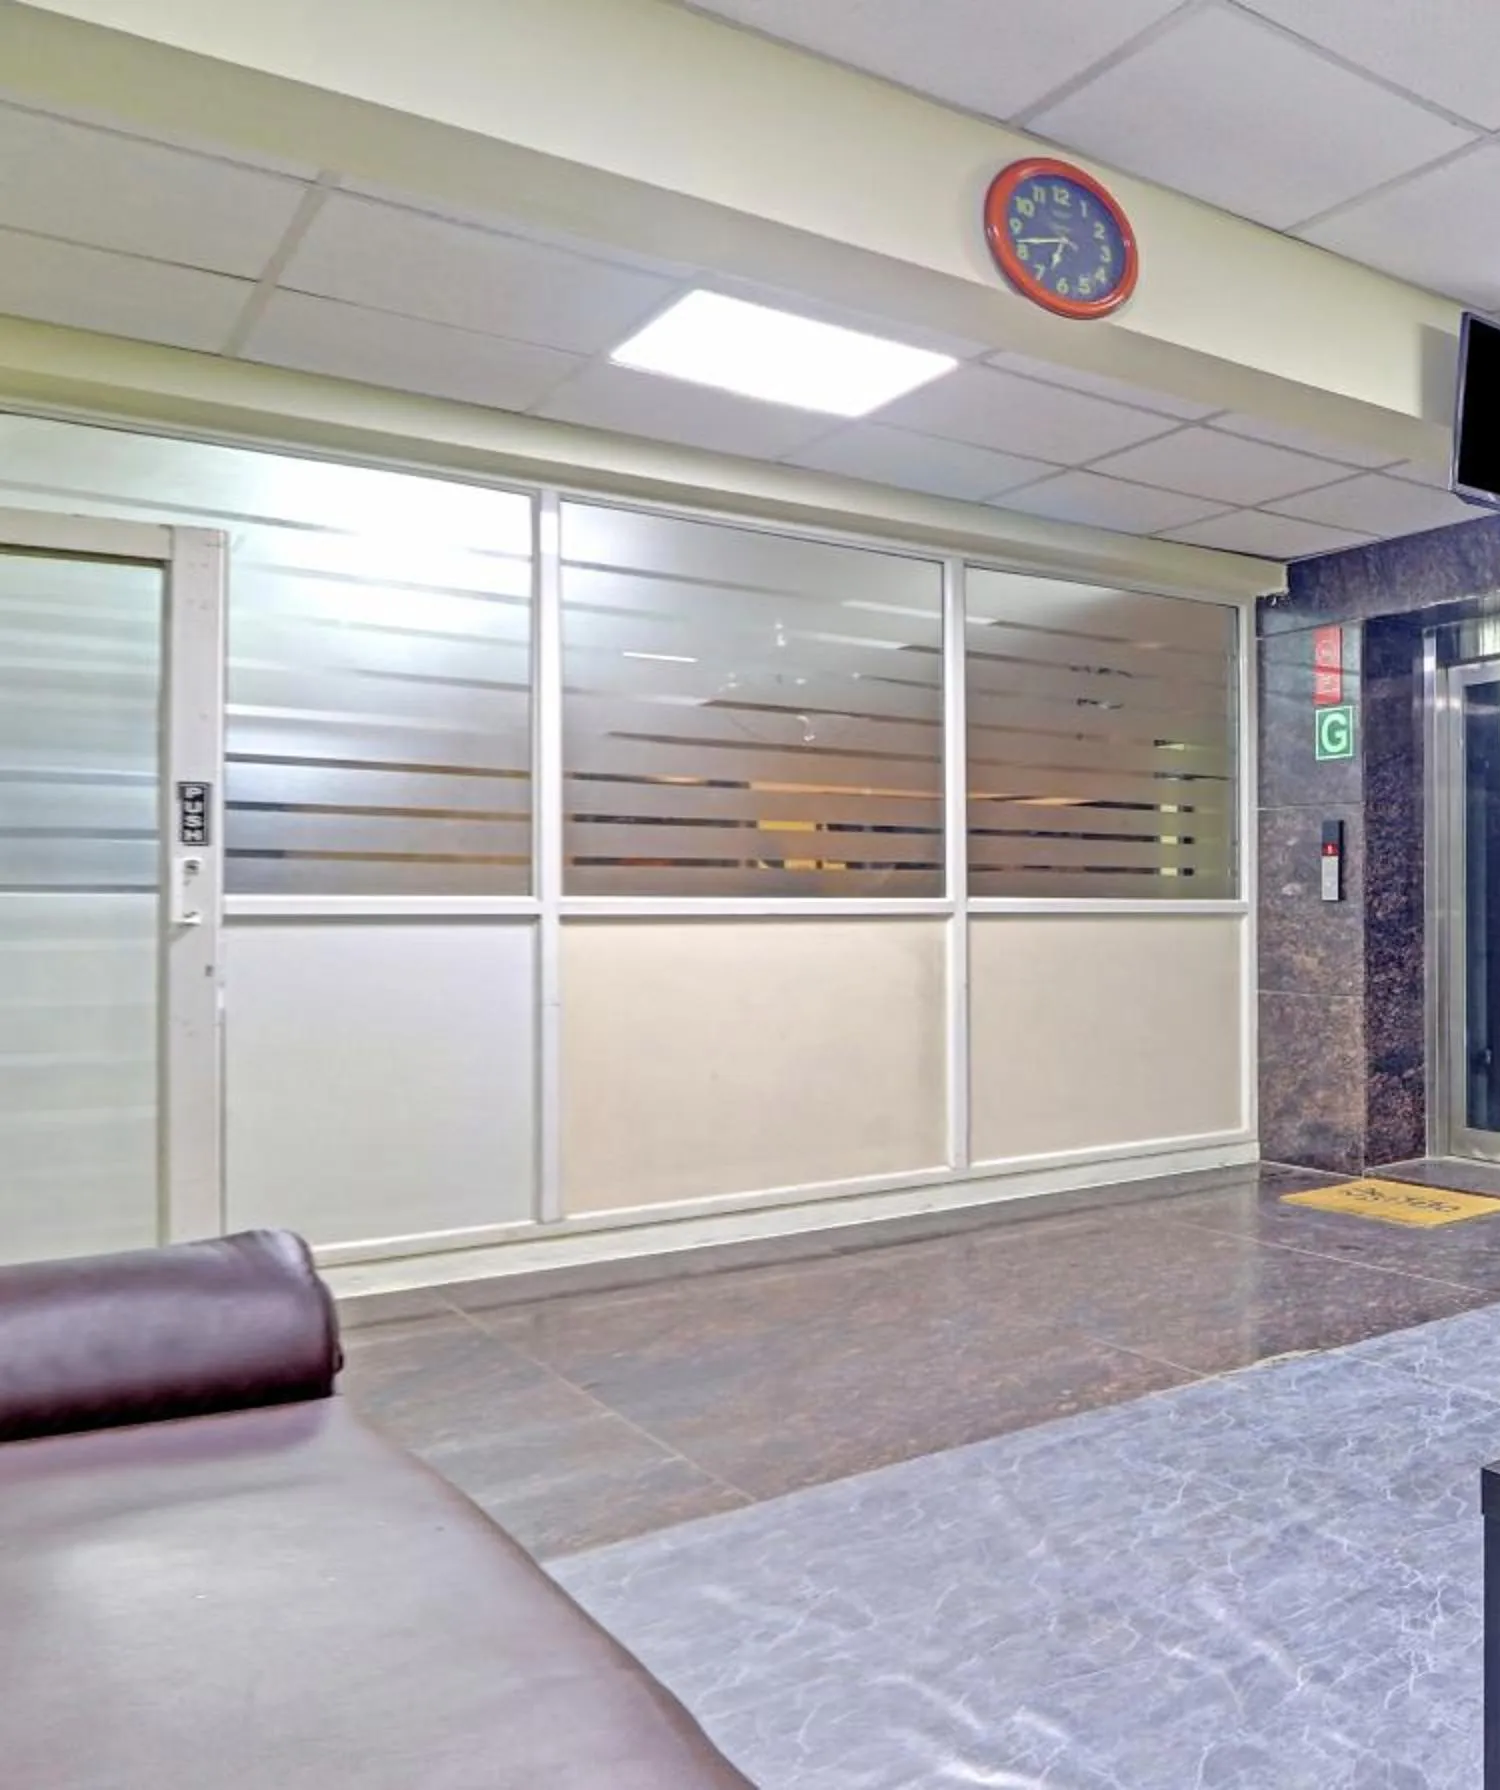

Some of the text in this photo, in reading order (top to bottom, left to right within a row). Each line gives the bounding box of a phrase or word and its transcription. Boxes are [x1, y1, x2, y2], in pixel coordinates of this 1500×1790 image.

[1052, 185, 1071, 206] 12
[1080, 200, 1088, 218] 1
[1009, 217, 1023, 235] 9
[1094, 221, 1106, 240] 2
[1016, 244, 1029, 261] 8
[1100, 245, 1112, 263] 3
[1033, 263, 1046, 281] 7
[1095, 267, 1107, 284] 4
[1056, 277, 1069, 295] 6
[1078, 275, 1091, 295] 5
[1321, 711, 1348, 753] G
[184, 787, 204, 842] PUSH
